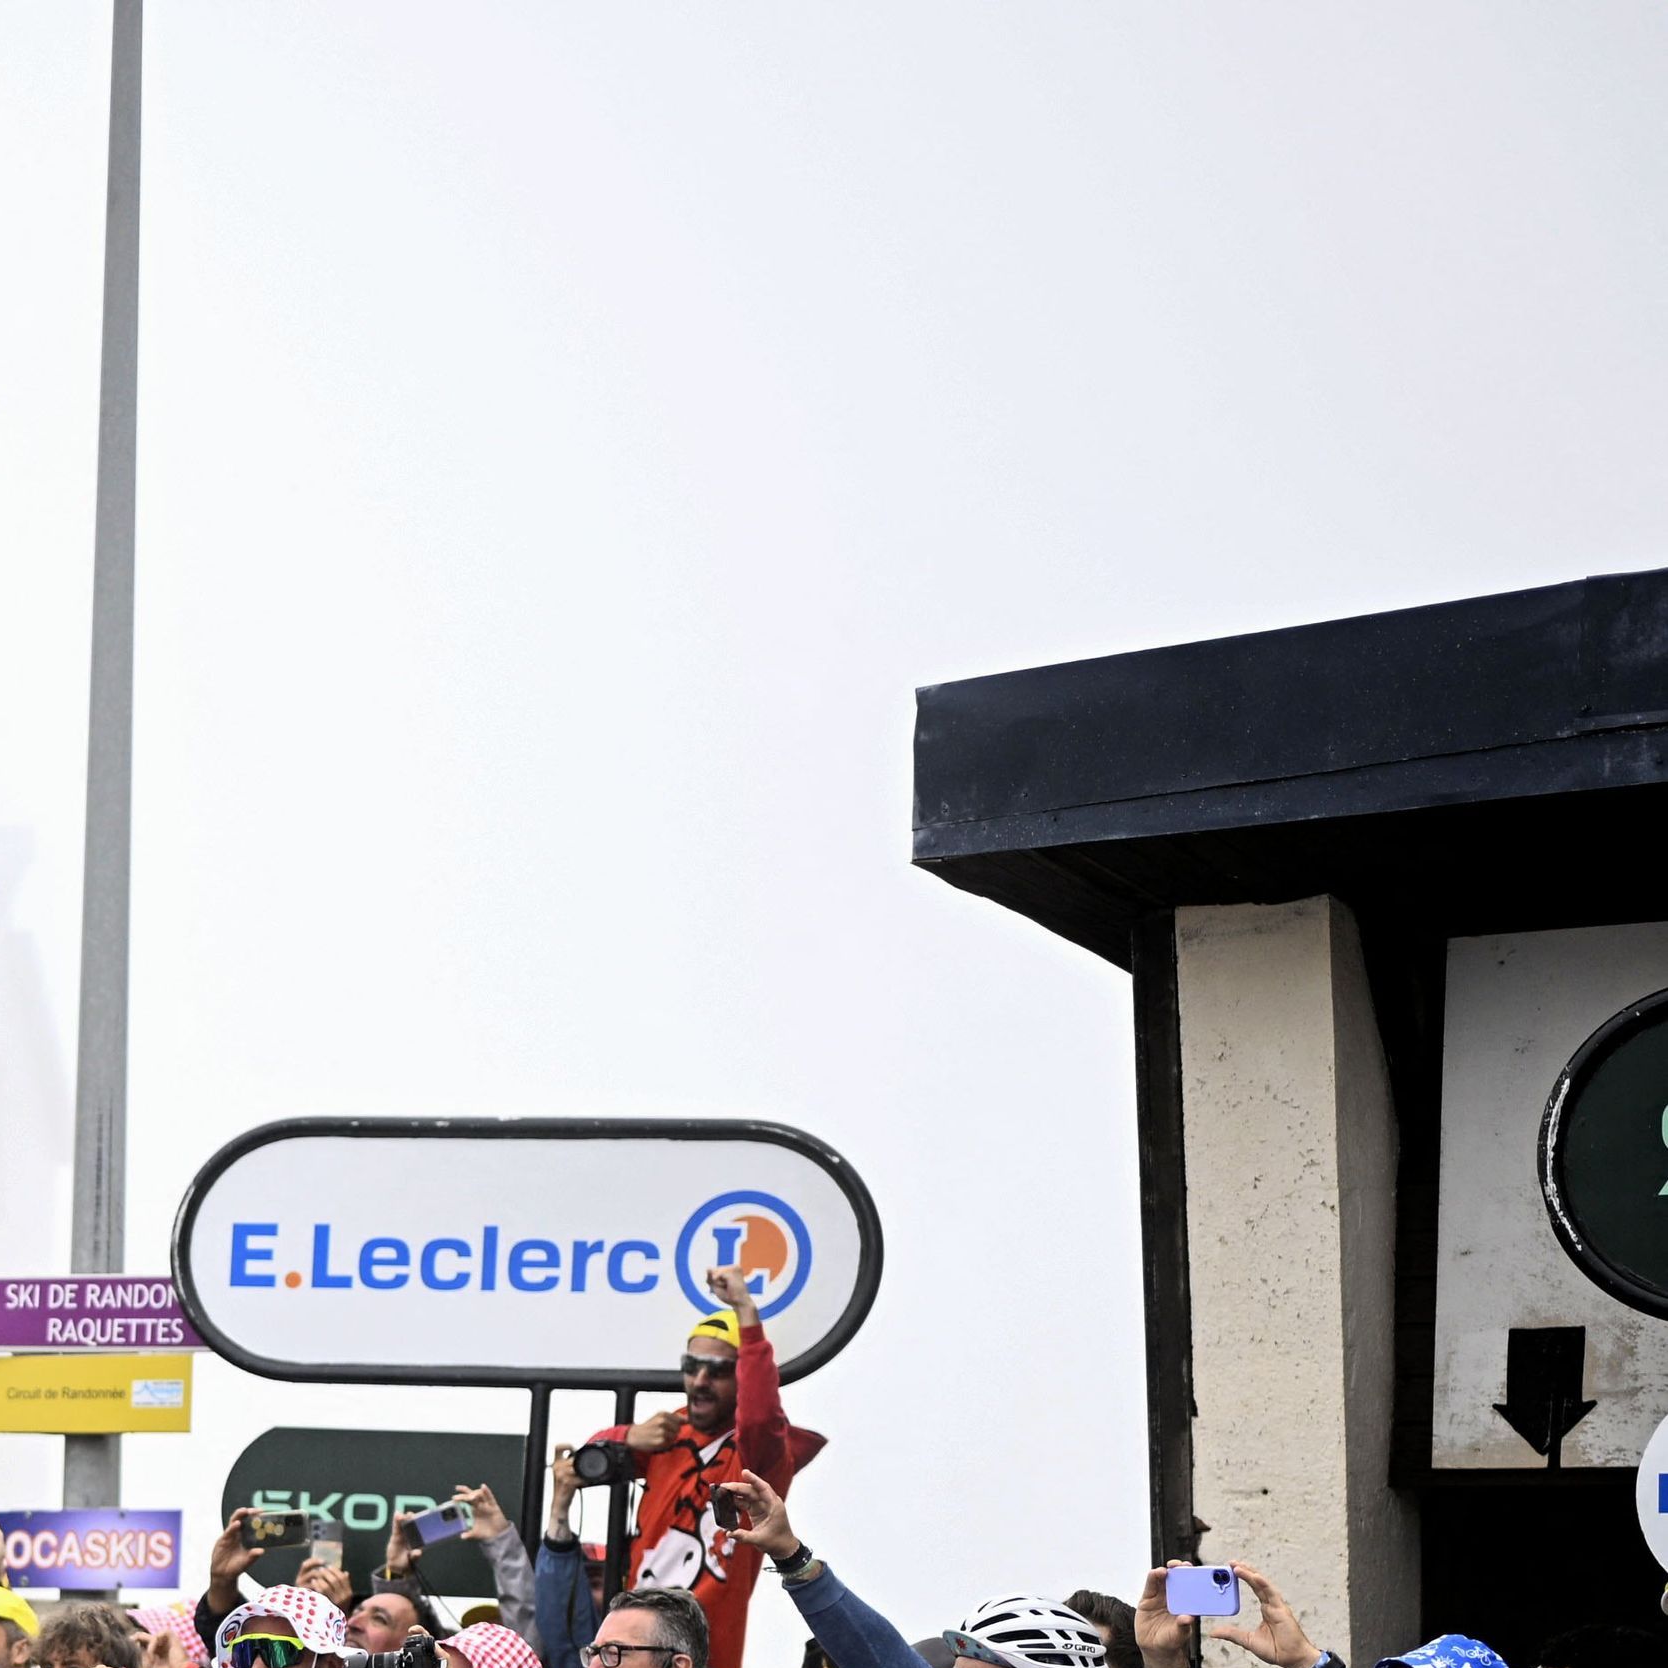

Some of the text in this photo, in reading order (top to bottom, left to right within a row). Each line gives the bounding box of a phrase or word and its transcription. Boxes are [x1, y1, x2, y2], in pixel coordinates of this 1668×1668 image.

[229, 1223, 660, 1293] E.Leclerc
[5, 1284, 40, 1309] SKI
[48, 1284, 78, 1309] DE
[46, 1318, 185, 1346] RAQUETTES
[7, 1386, 41, 1400] Circuit
[45, 1386, 59, 1400] de
[62, 1386, 126, 1400] Randonnée
[4, 1529, 174, 1570] OCASKIS
